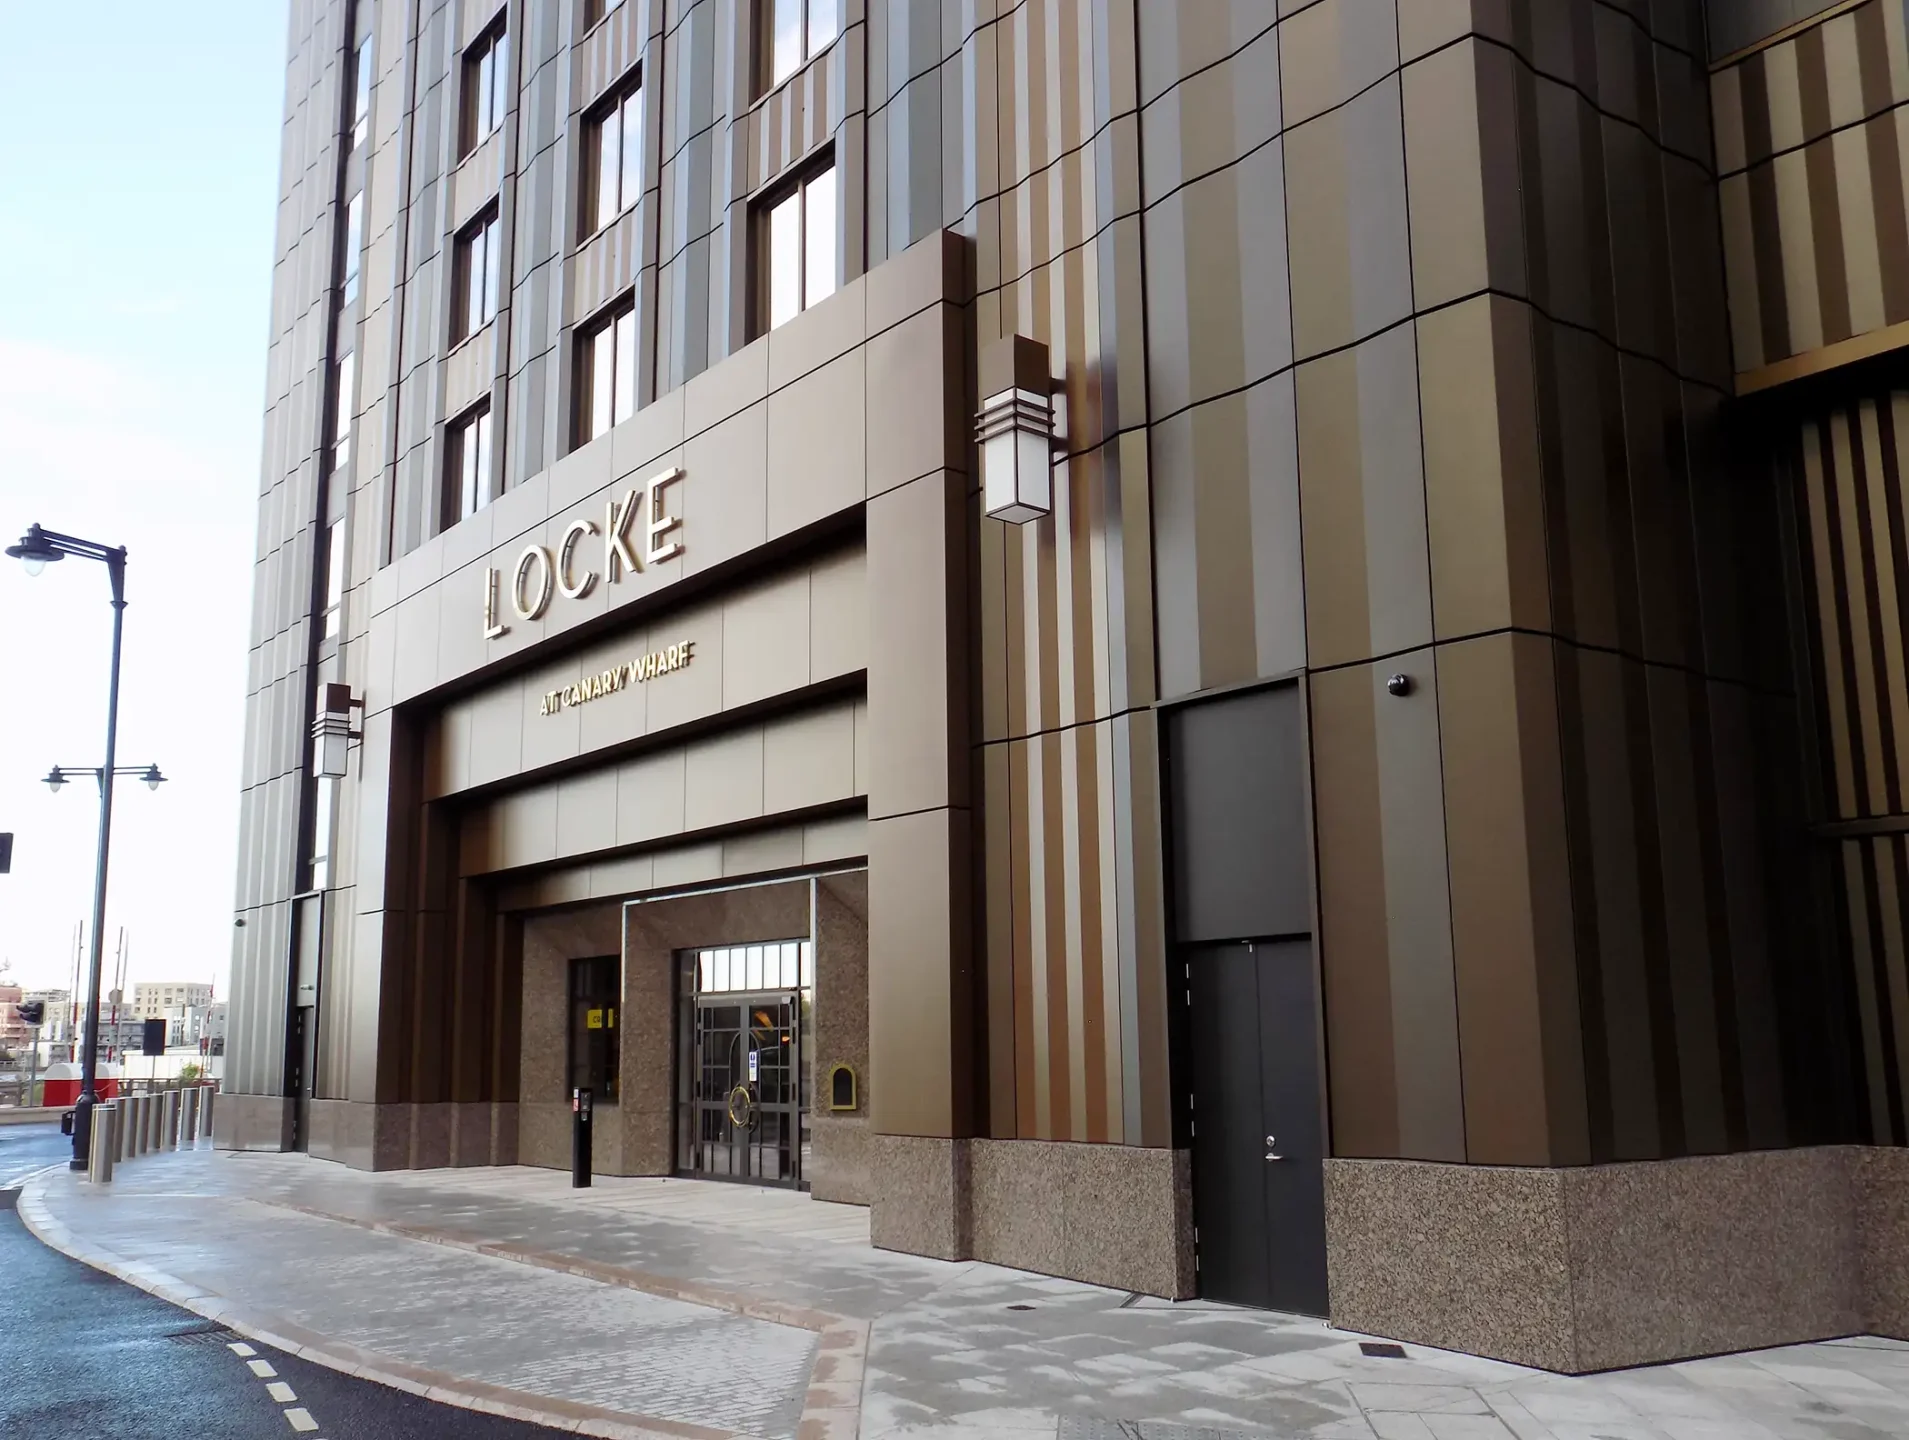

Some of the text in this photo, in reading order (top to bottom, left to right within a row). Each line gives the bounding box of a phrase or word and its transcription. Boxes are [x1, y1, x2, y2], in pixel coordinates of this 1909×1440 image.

[483, 466, 680, 640] LOCKE
[539, 639, 690, 716] AT CANARY WHARF
